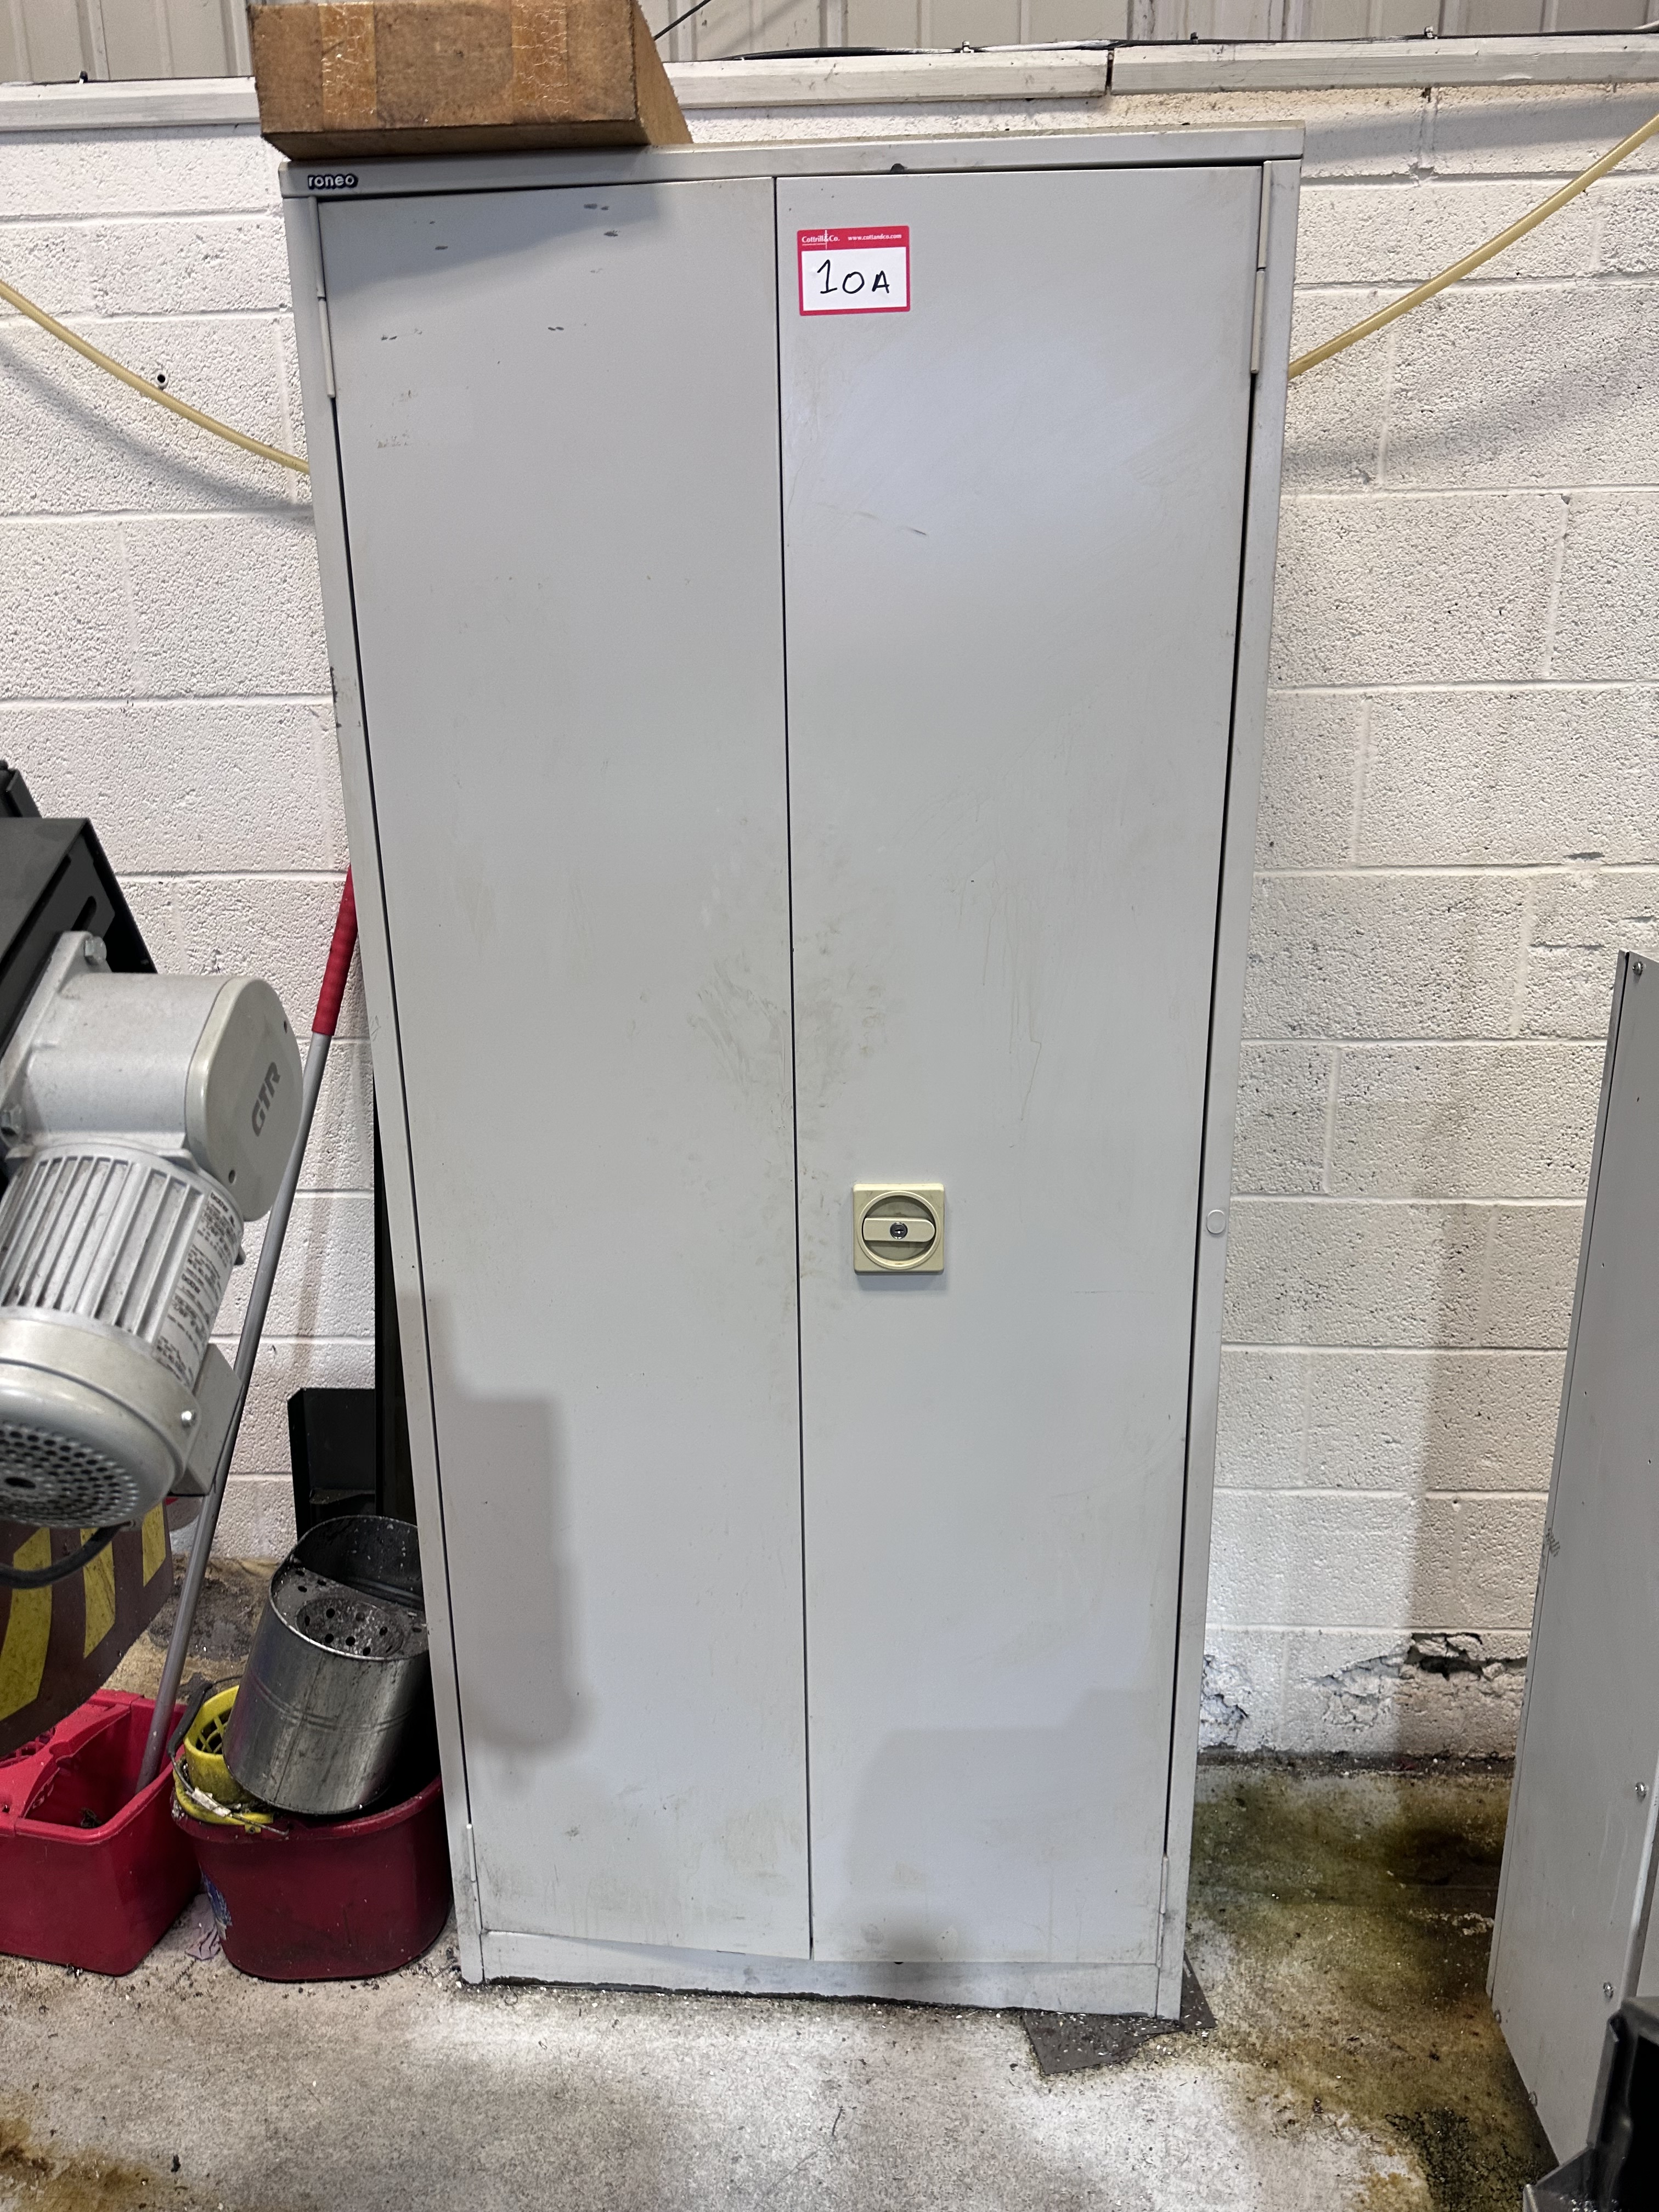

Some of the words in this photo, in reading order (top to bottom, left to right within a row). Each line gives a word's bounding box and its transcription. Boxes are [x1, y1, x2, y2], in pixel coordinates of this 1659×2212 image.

[308, 175, 355, 187] roneo
[817, 259, 890, 294] 10A
[251, 1062, 281, 1137] GTR
